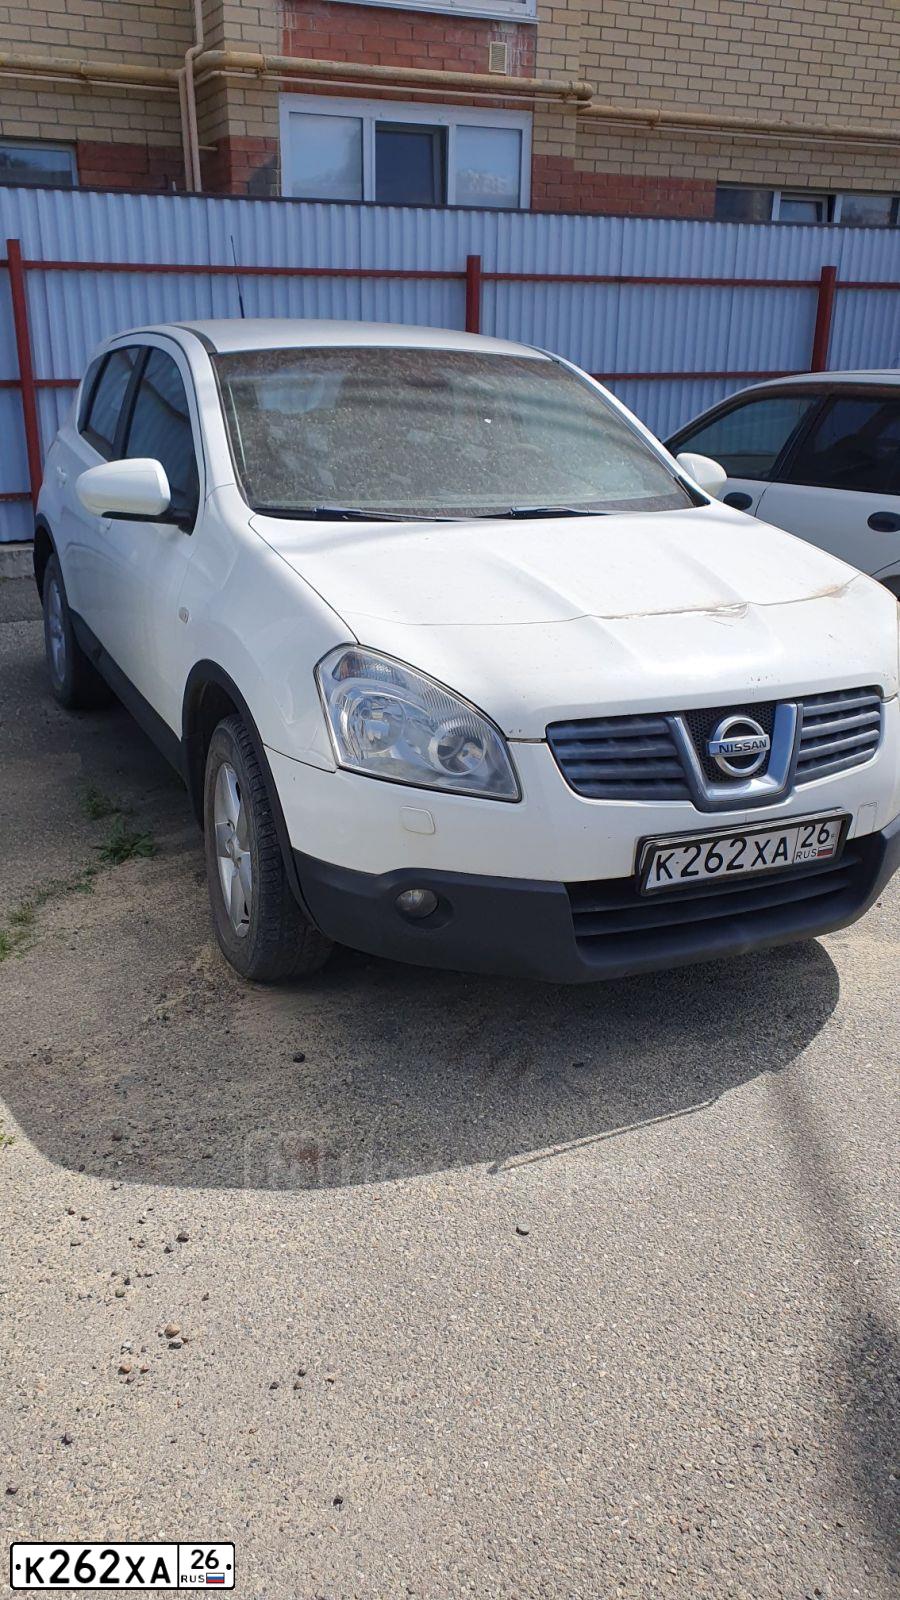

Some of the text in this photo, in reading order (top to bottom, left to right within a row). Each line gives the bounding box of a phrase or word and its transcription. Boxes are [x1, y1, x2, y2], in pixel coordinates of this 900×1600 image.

[718, 739, 768, 754] NISSAN
[800, 822, 830, 849] 26
[795, 848, 817, 860] RUS
